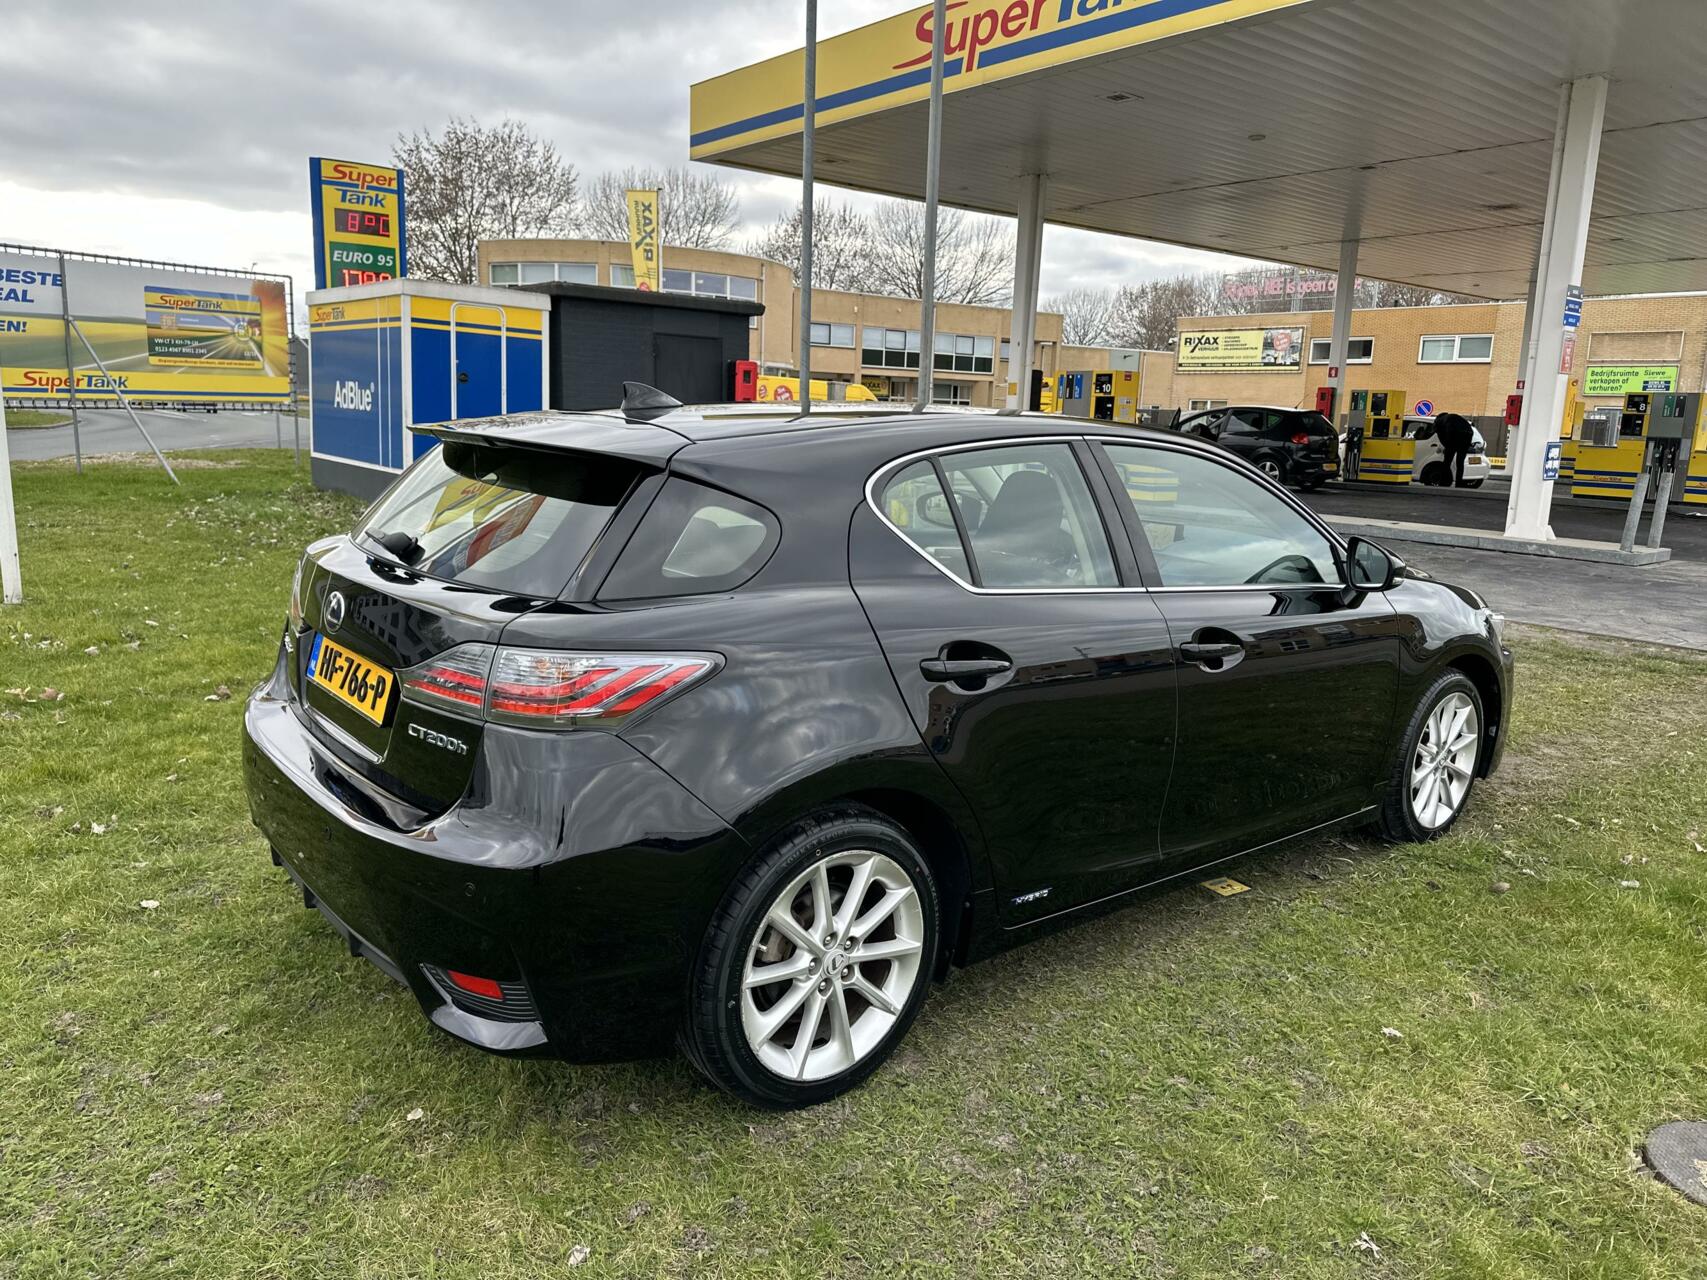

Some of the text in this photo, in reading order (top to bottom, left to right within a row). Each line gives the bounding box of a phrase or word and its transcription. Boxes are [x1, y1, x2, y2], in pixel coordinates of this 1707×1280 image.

[320, 163, 396, 190] Super
[334, 188, 387, 208] Tank
[333, 250, 394, 267] EURO 95
[314, 306, 345, 327] SuperTank
[1184, 334, 1220, 354] RIXAX
[1590, 370, 1640, 378] Bedrijfsruimte
[1102, 384, 1111, 393] 10
[1639, 403, 1646, 411] 8
[319, 644, 387, 711] HF-766-P
[408, 722, 469, 756] CT200h
